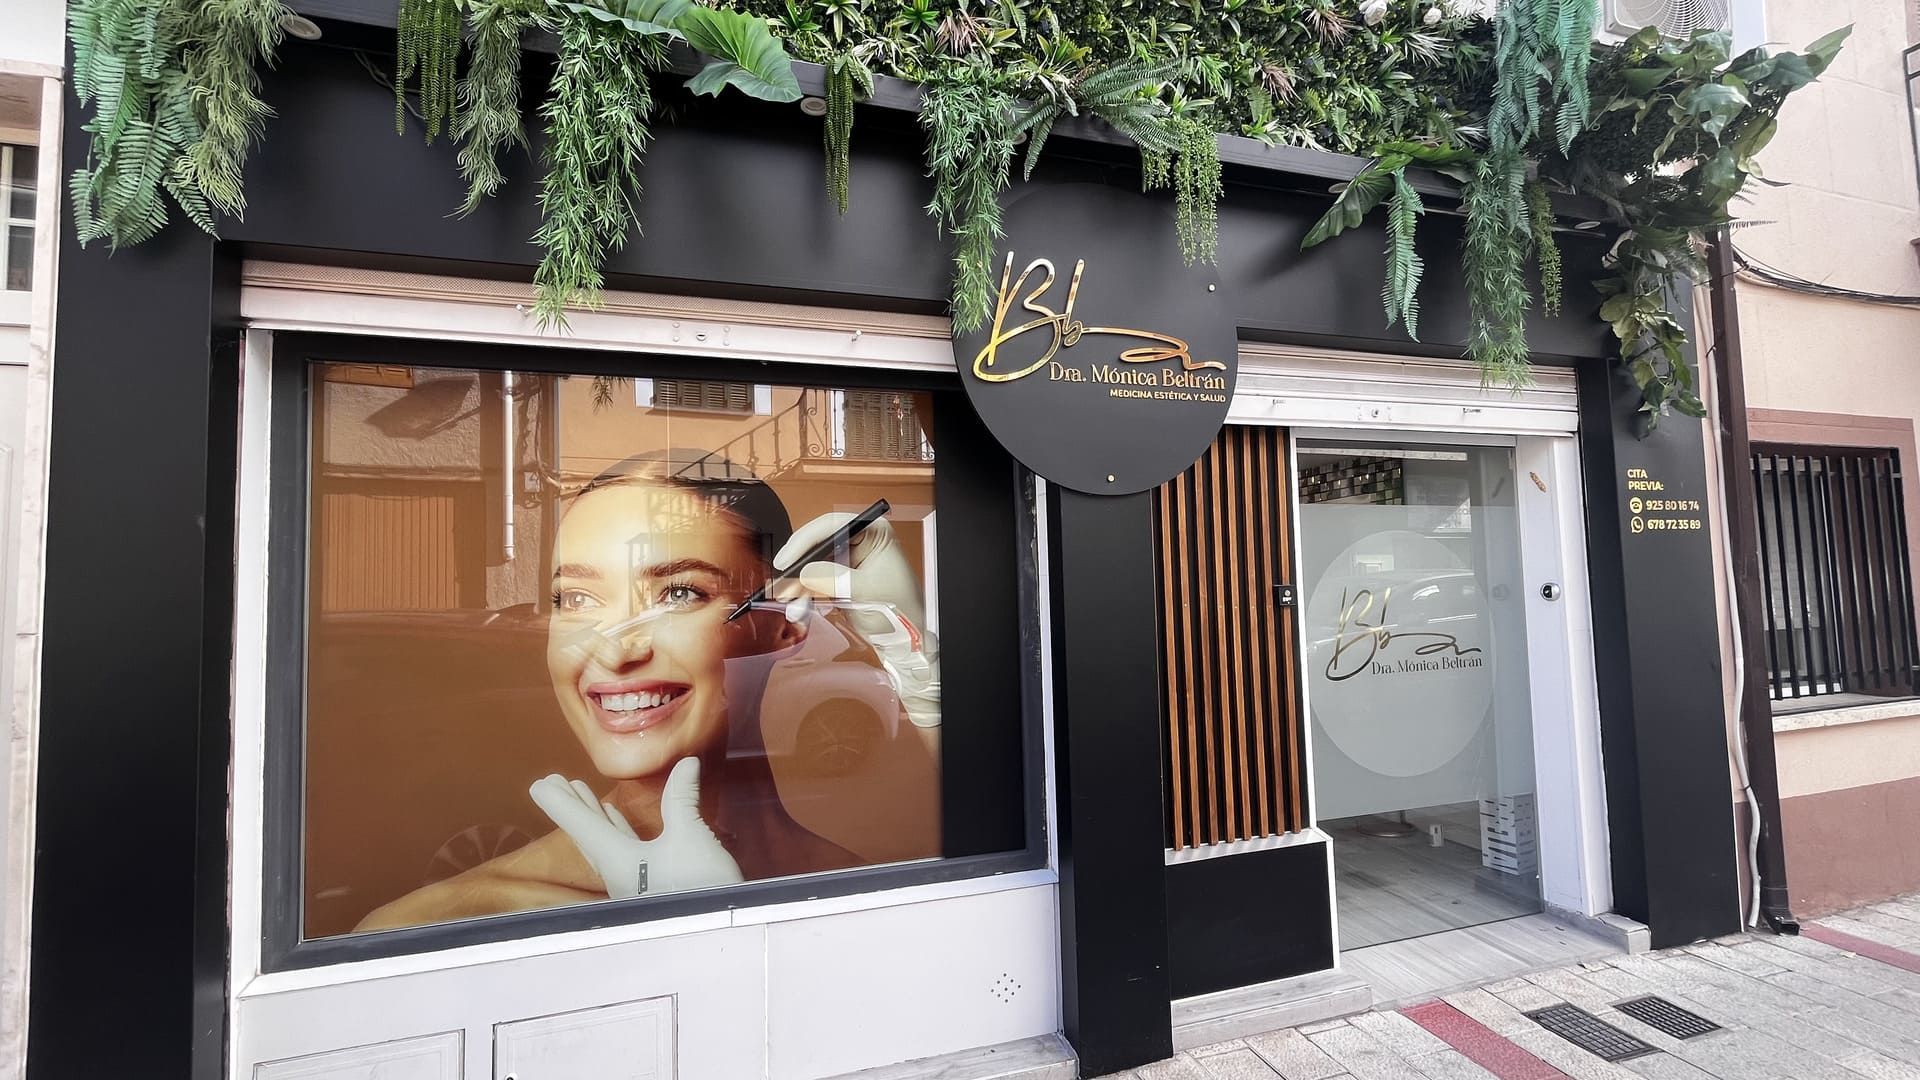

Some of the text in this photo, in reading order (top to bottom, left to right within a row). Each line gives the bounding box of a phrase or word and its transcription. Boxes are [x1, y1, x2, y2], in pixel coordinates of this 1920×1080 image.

[1050, 361, 1225, 390] Dra. Mónica Beltrán
[1110, 388, 1226, 403] MEDICINA ESTÉTICA Y SALUD
[1627, 468, 1648, 479] CITA
[1628, 480, 1664, 491] PREVIA:
[1646, 500, 1700, 511] 925 80 16 74
[1647, 519, 1701, 530] 678 72 35 89
[1372, 655, 1483, 675] Dra. Mónica Beltrán
